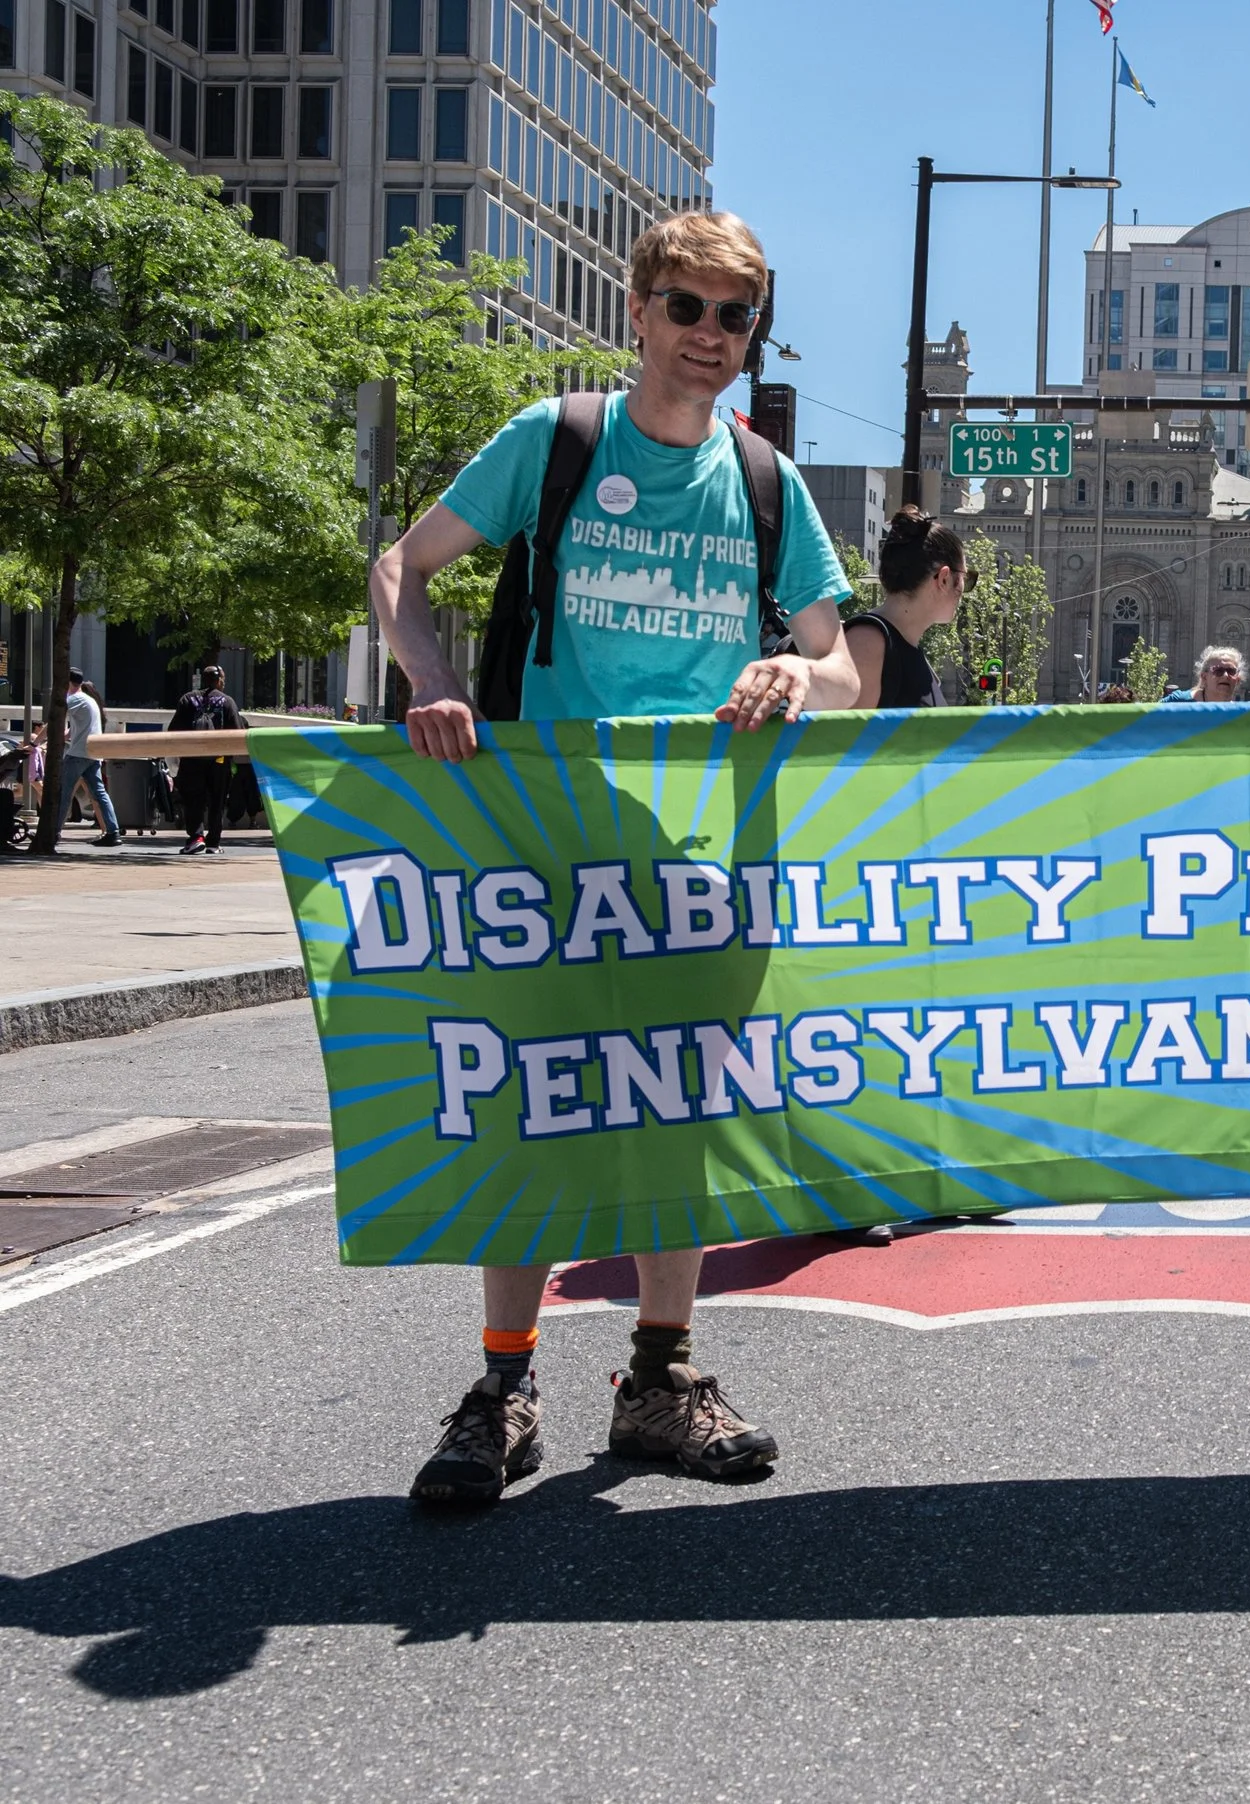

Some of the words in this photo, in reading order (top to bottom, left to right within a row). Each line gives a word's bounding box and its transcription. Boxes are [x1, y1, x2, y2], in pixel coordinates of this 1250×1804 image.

[963, 447, 1018, 472] 15th
[1030, 447, 1059, 472] St
[973, 429, 1001, 442] 100
[1032, 429, 1039, 442] 1
[571, 517, 696, 559] DISABILITY
[701, 534, 757, 569] PRIDE
[564, 595, 748, 645] PHILADELPHIA
[330, 846, 1098, 975] DISABILITY
